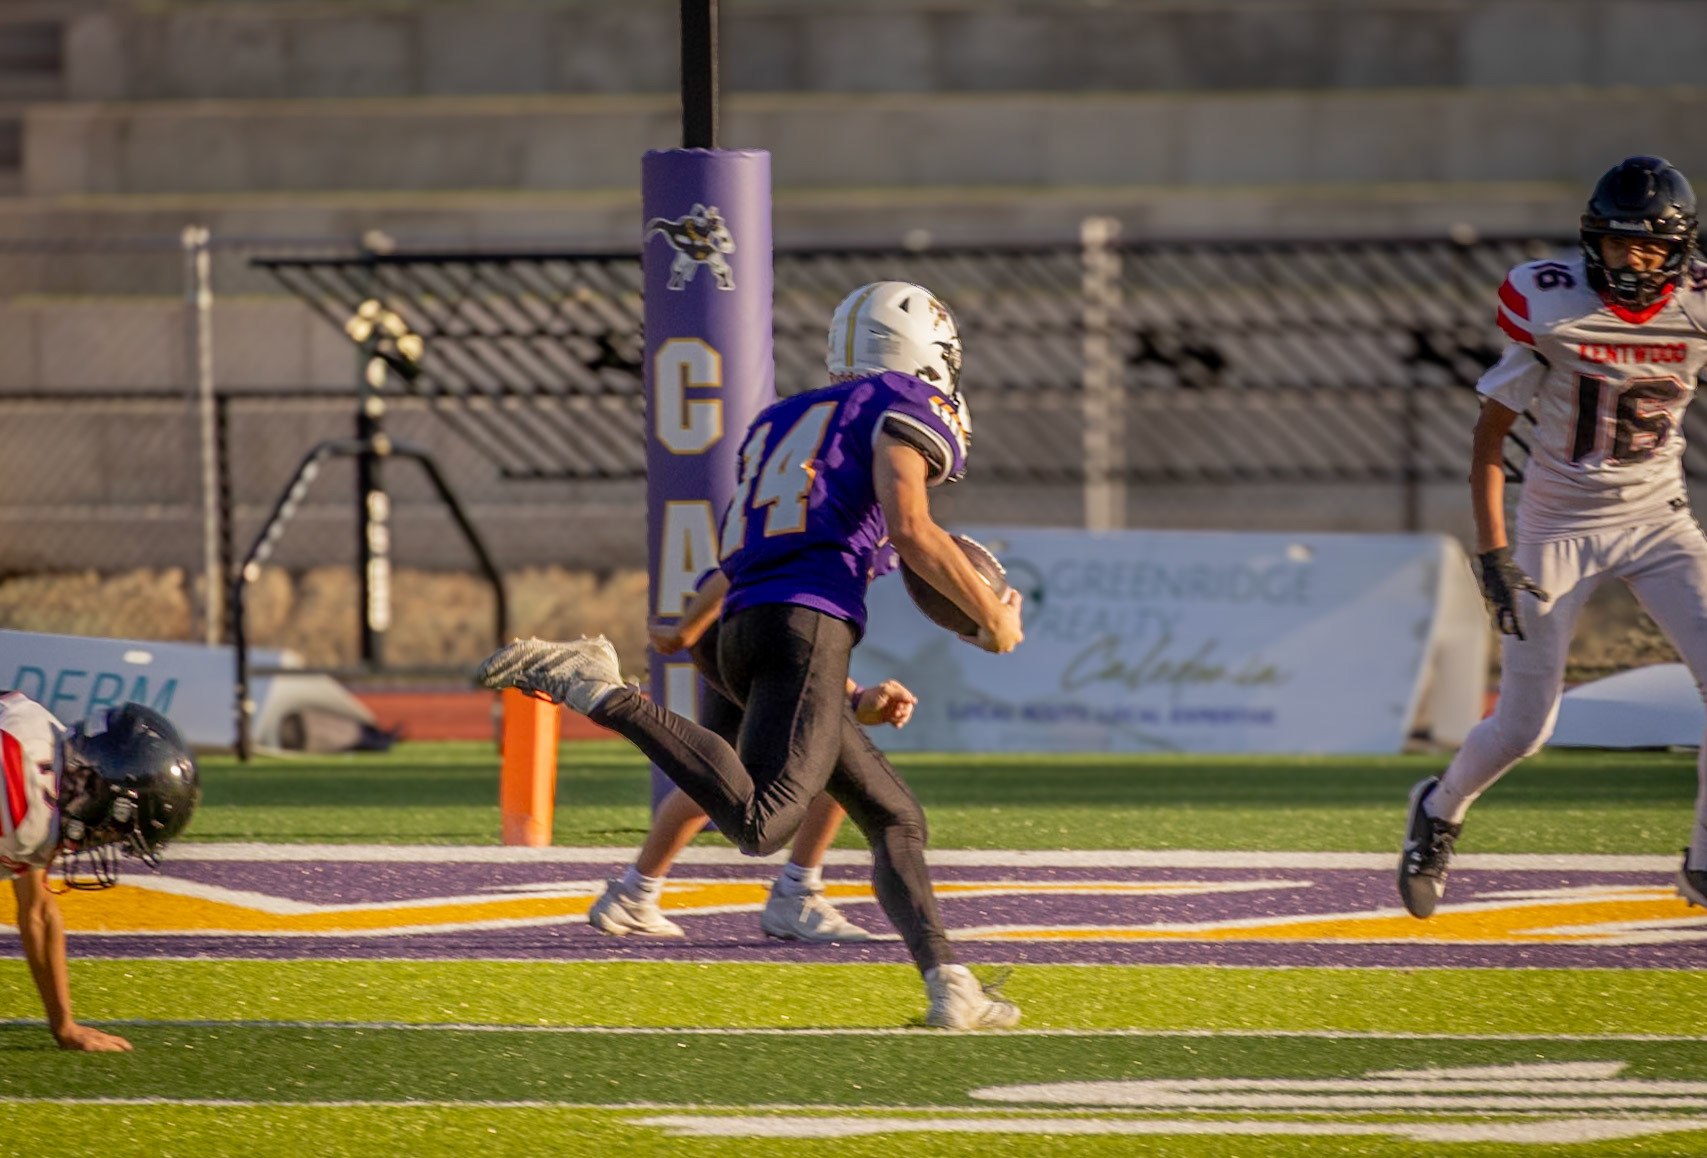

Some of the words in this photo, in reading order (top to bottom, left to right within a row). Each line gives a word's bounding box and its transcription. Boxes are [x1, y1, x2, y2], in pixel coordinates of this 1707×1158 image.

[1528, 260, 1577, 292] 16
[1578, 342, 1688, 365] KENTWOOD
[1565, 370, 1687, 467] 16
[718, 400, 838, 564] 14
[1049, 558, 1314, 606] GREENRIDGE
